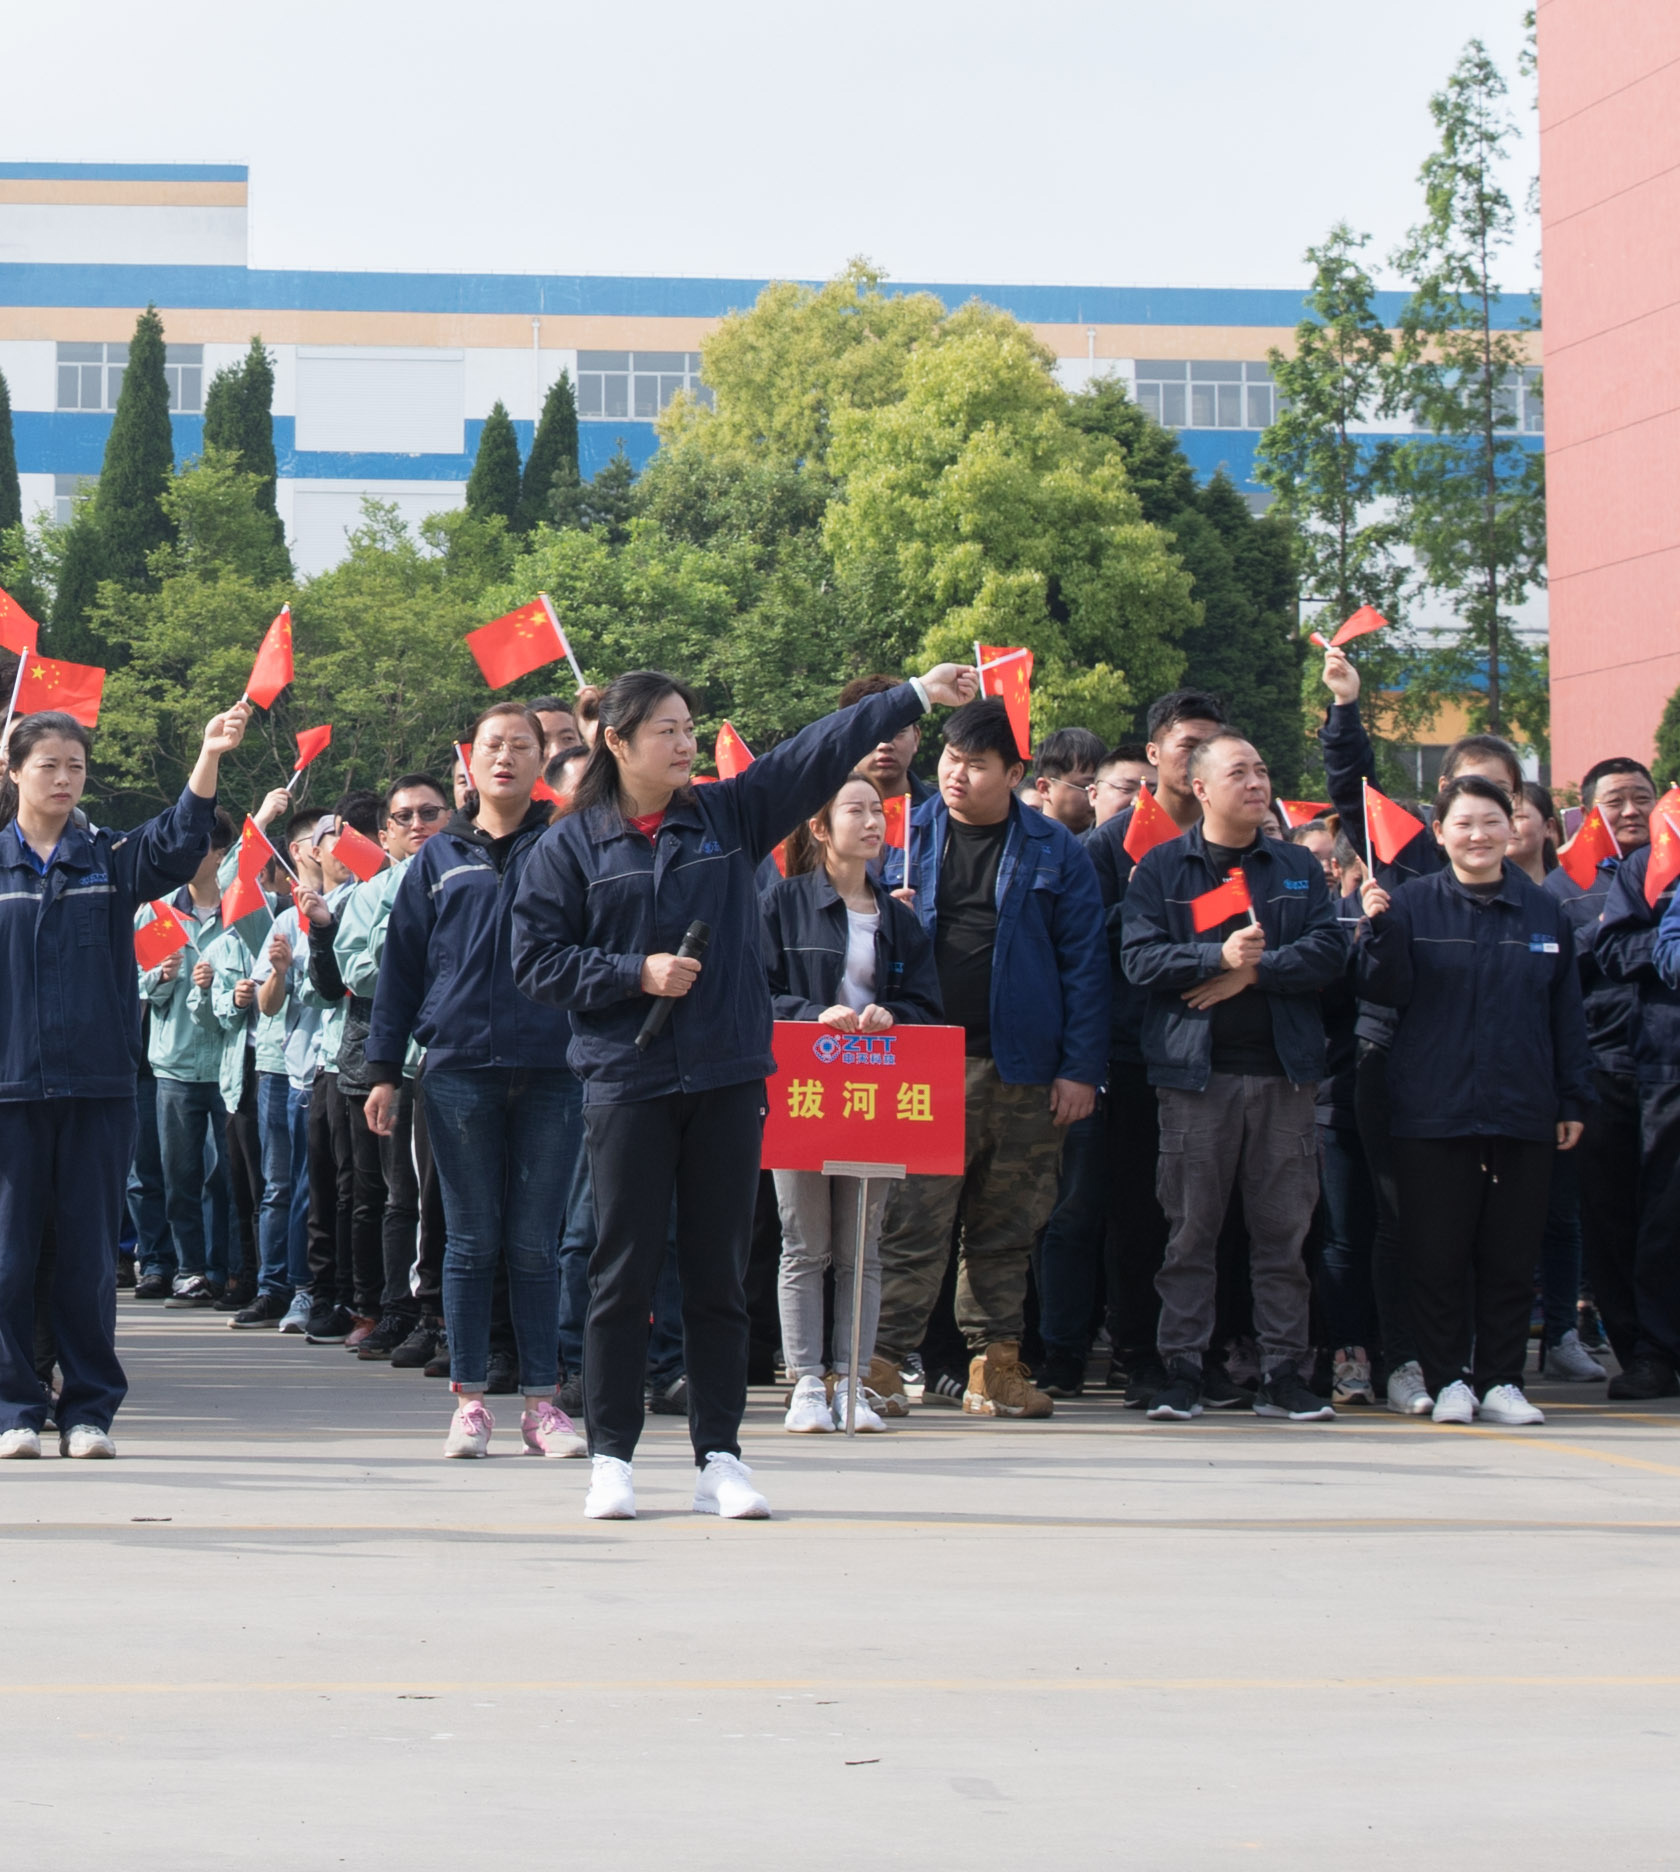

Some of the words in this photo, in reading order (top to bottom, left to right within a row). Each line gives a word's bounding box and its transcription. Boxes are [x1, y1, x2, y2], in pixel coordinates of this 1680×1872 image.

[842, 1034, 897, 1052] ZTT
[787, 1079, 934, 1121] 拔河组
